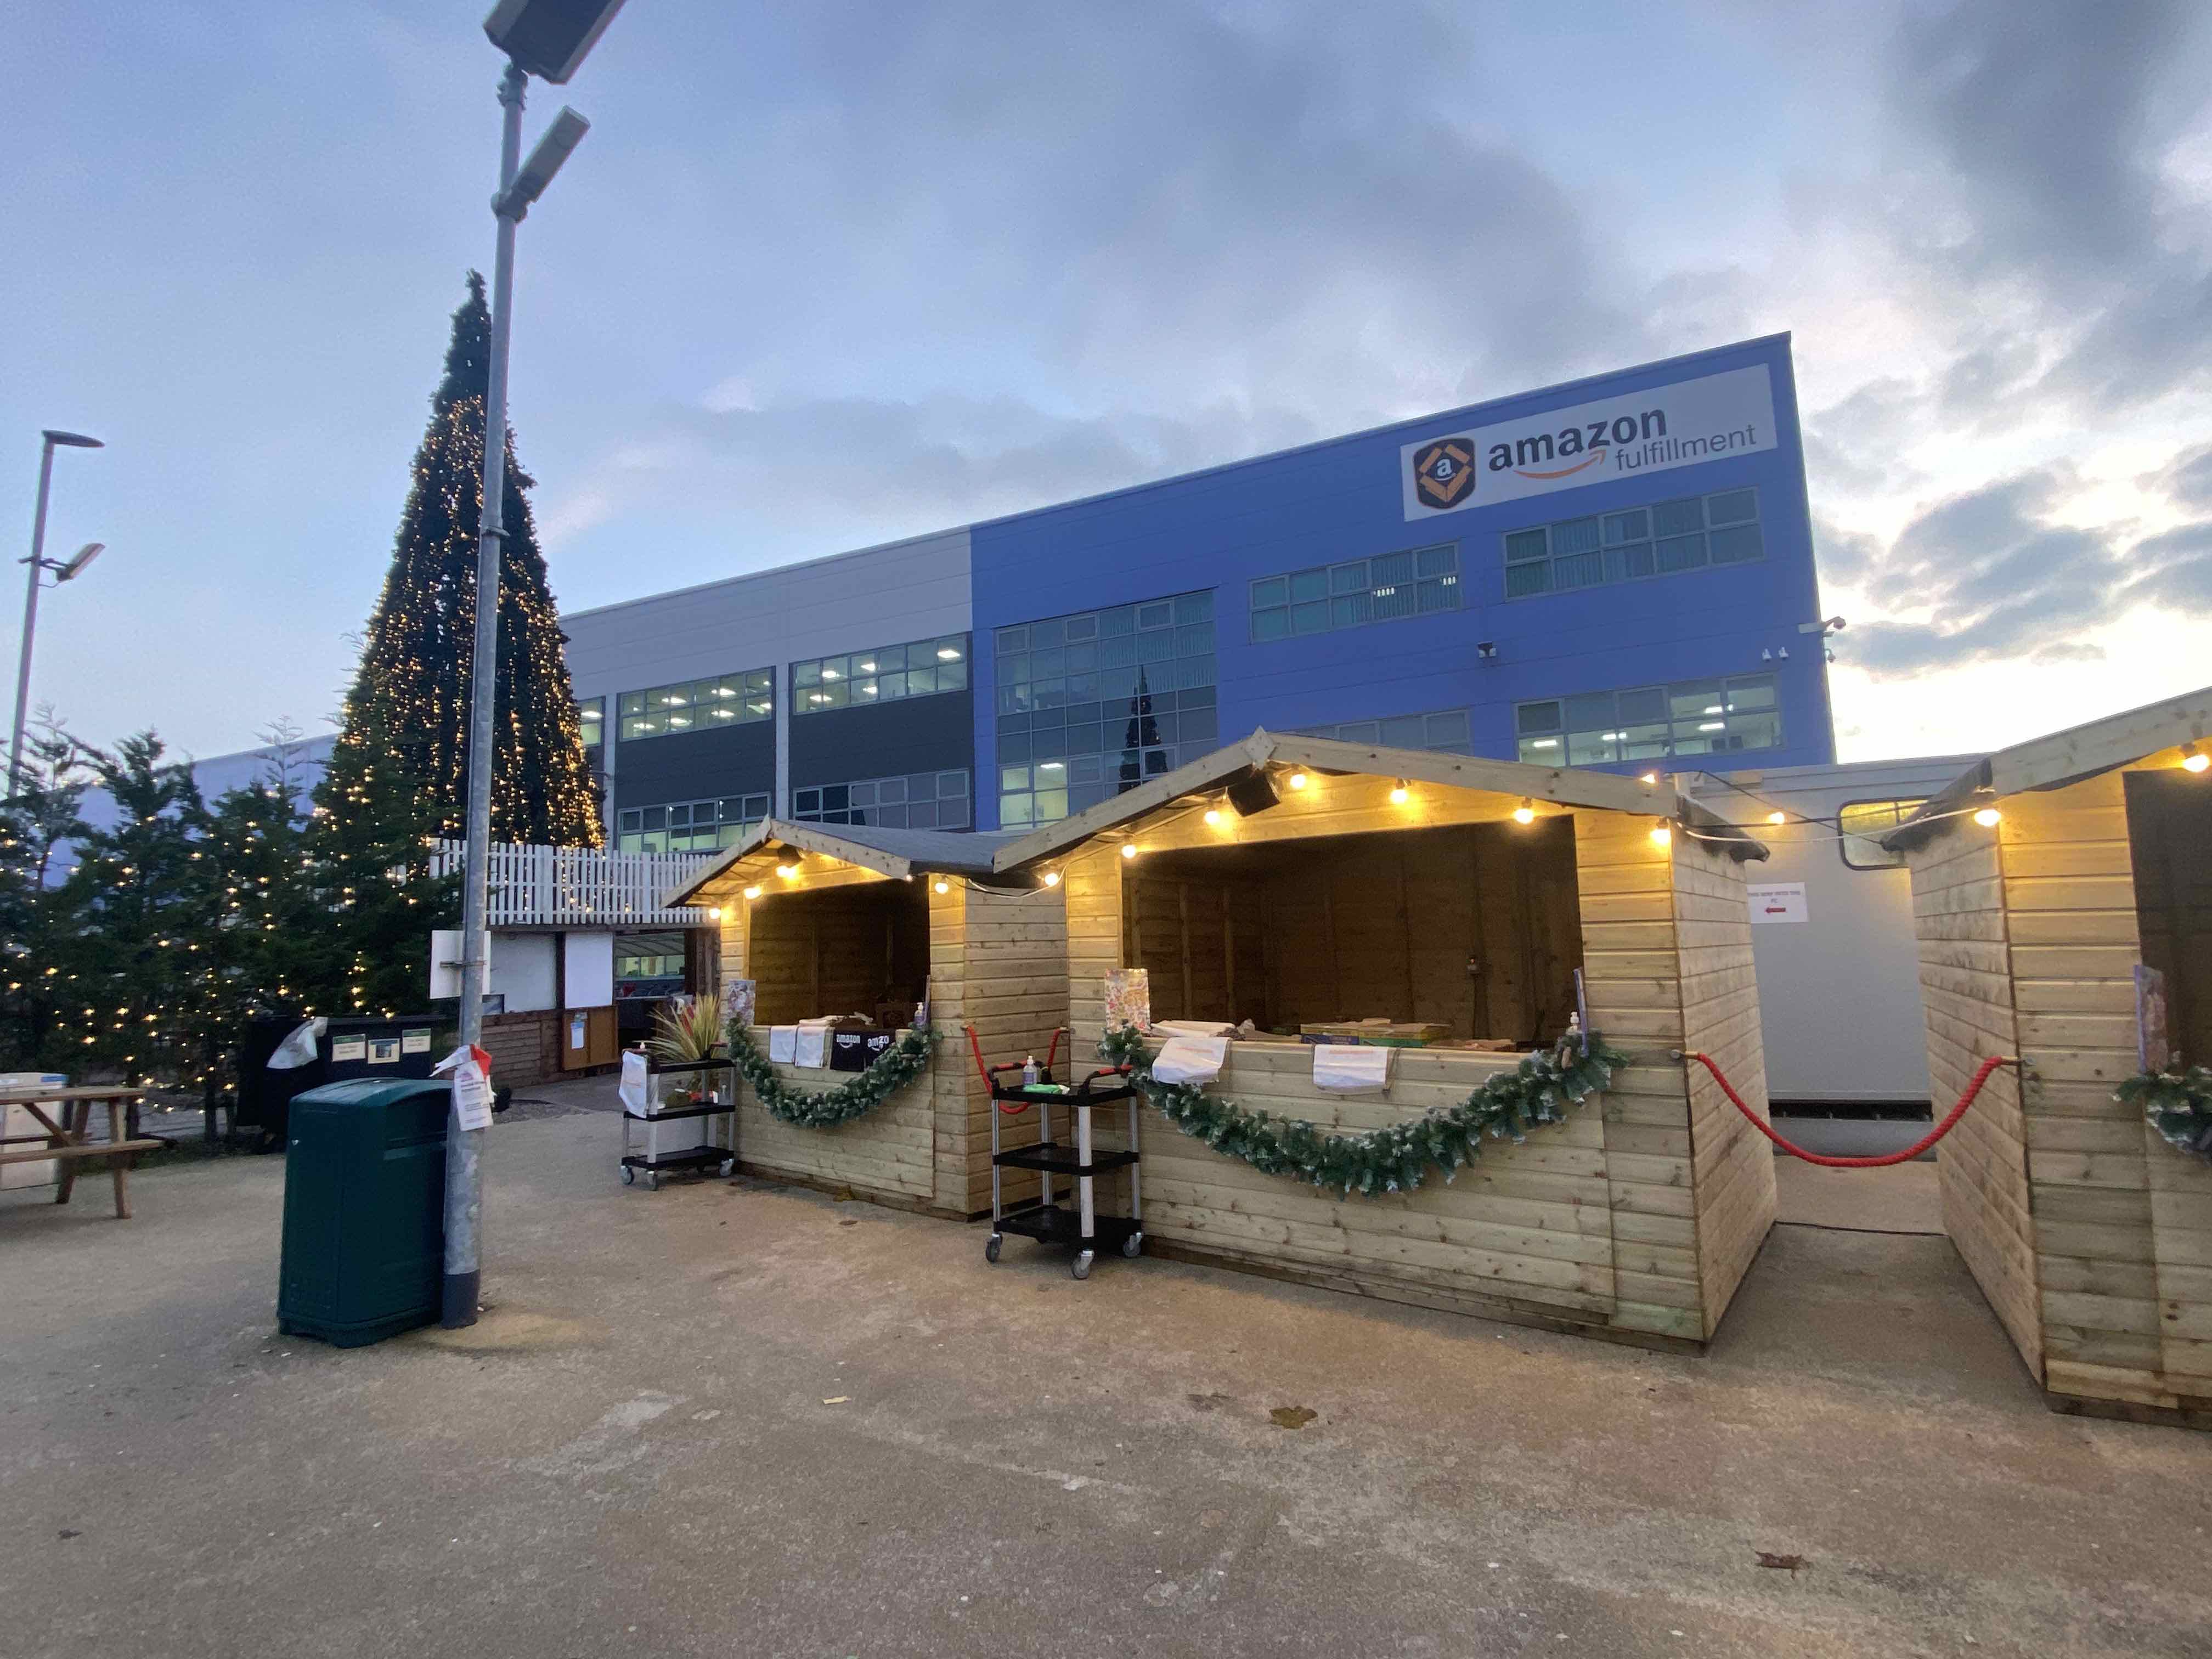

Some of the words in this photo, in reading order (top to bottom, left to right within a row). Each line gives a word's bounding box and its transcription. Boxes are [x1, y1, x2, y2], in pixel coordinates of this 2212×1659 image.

[1488, 410, 1666, 471] amazon
[1615, 425, 1756, 471] fulfillment
[836, 1034, 860, 1043] amazon
